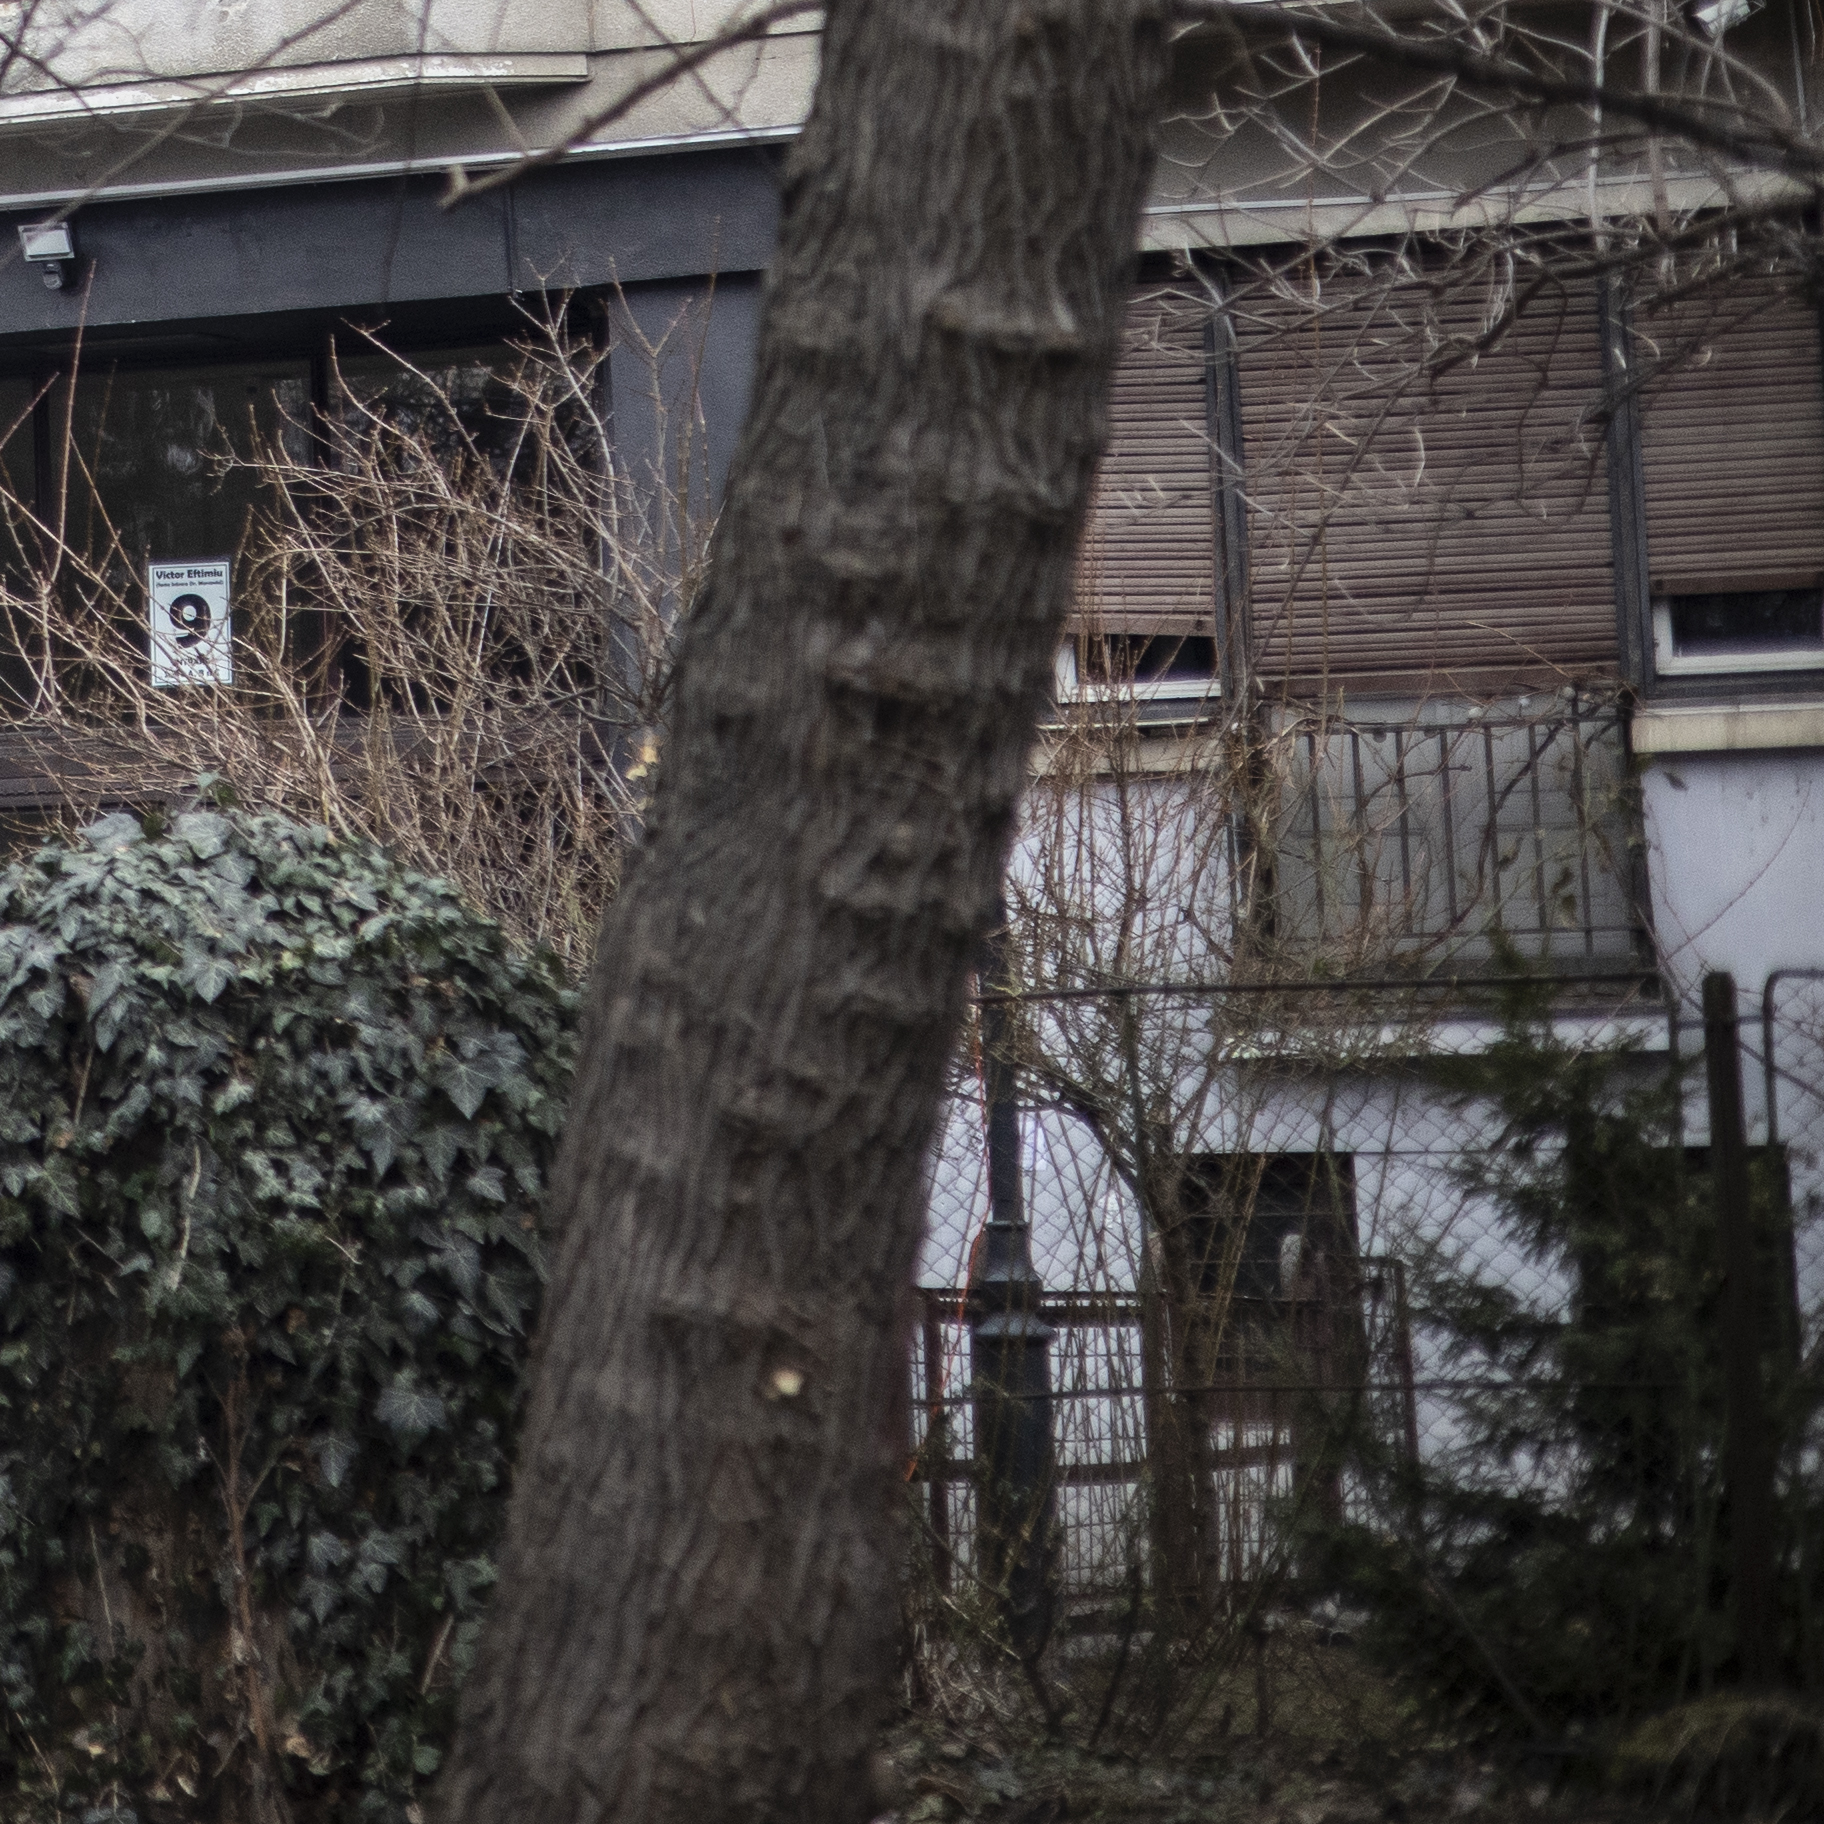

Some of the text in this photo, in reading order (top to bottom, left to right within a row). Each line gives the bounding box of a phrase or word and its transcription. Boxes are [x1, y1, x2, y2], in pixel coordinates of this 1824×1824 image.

[156, 568, 223, 580] Victor Eftimiu
[169, 593, 212, 649] 9
